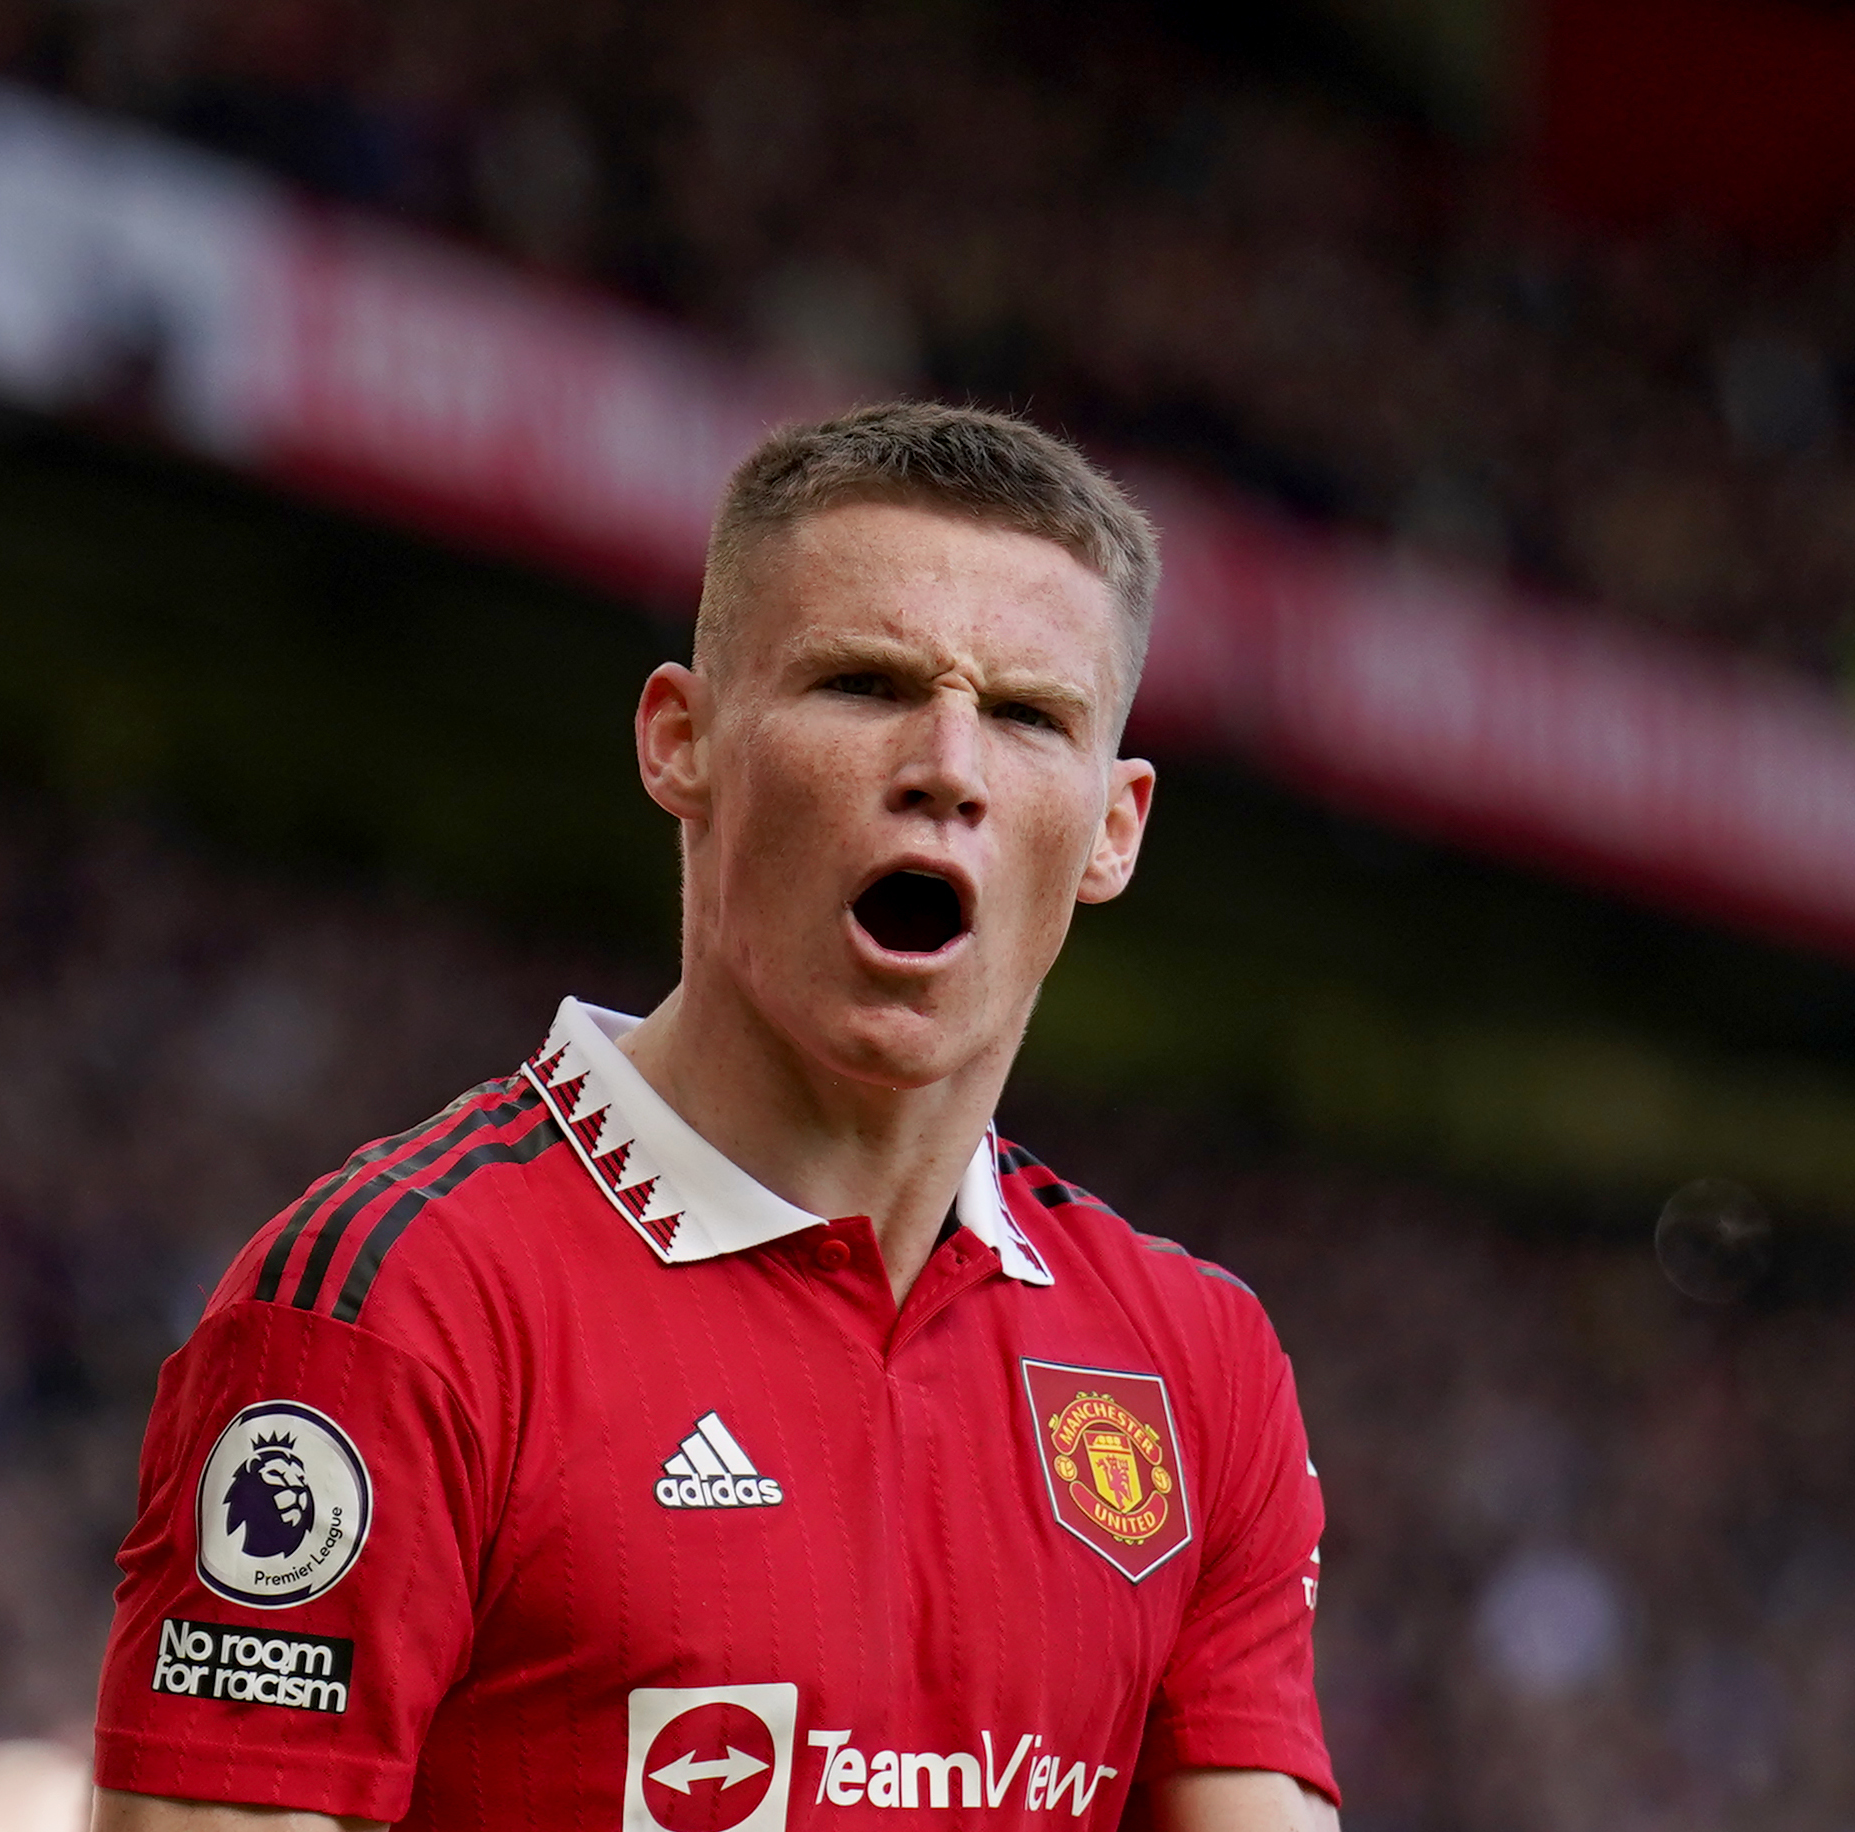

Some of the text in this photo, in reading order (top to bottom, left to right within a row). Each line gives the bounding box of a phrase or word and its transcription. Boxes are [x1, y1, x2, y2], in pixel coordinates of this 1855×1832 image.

[1059, 1401, 1155, 1455] MANCHESTER
[655, 1472, 783, 1506] adidas
[254, 1506, 343, 1586] Premier League
[1094, 1503, 1157, 1533] UNITED
[158, 1618, 333, 1676] No room
[152, 1654, 347, 1713] for racism
